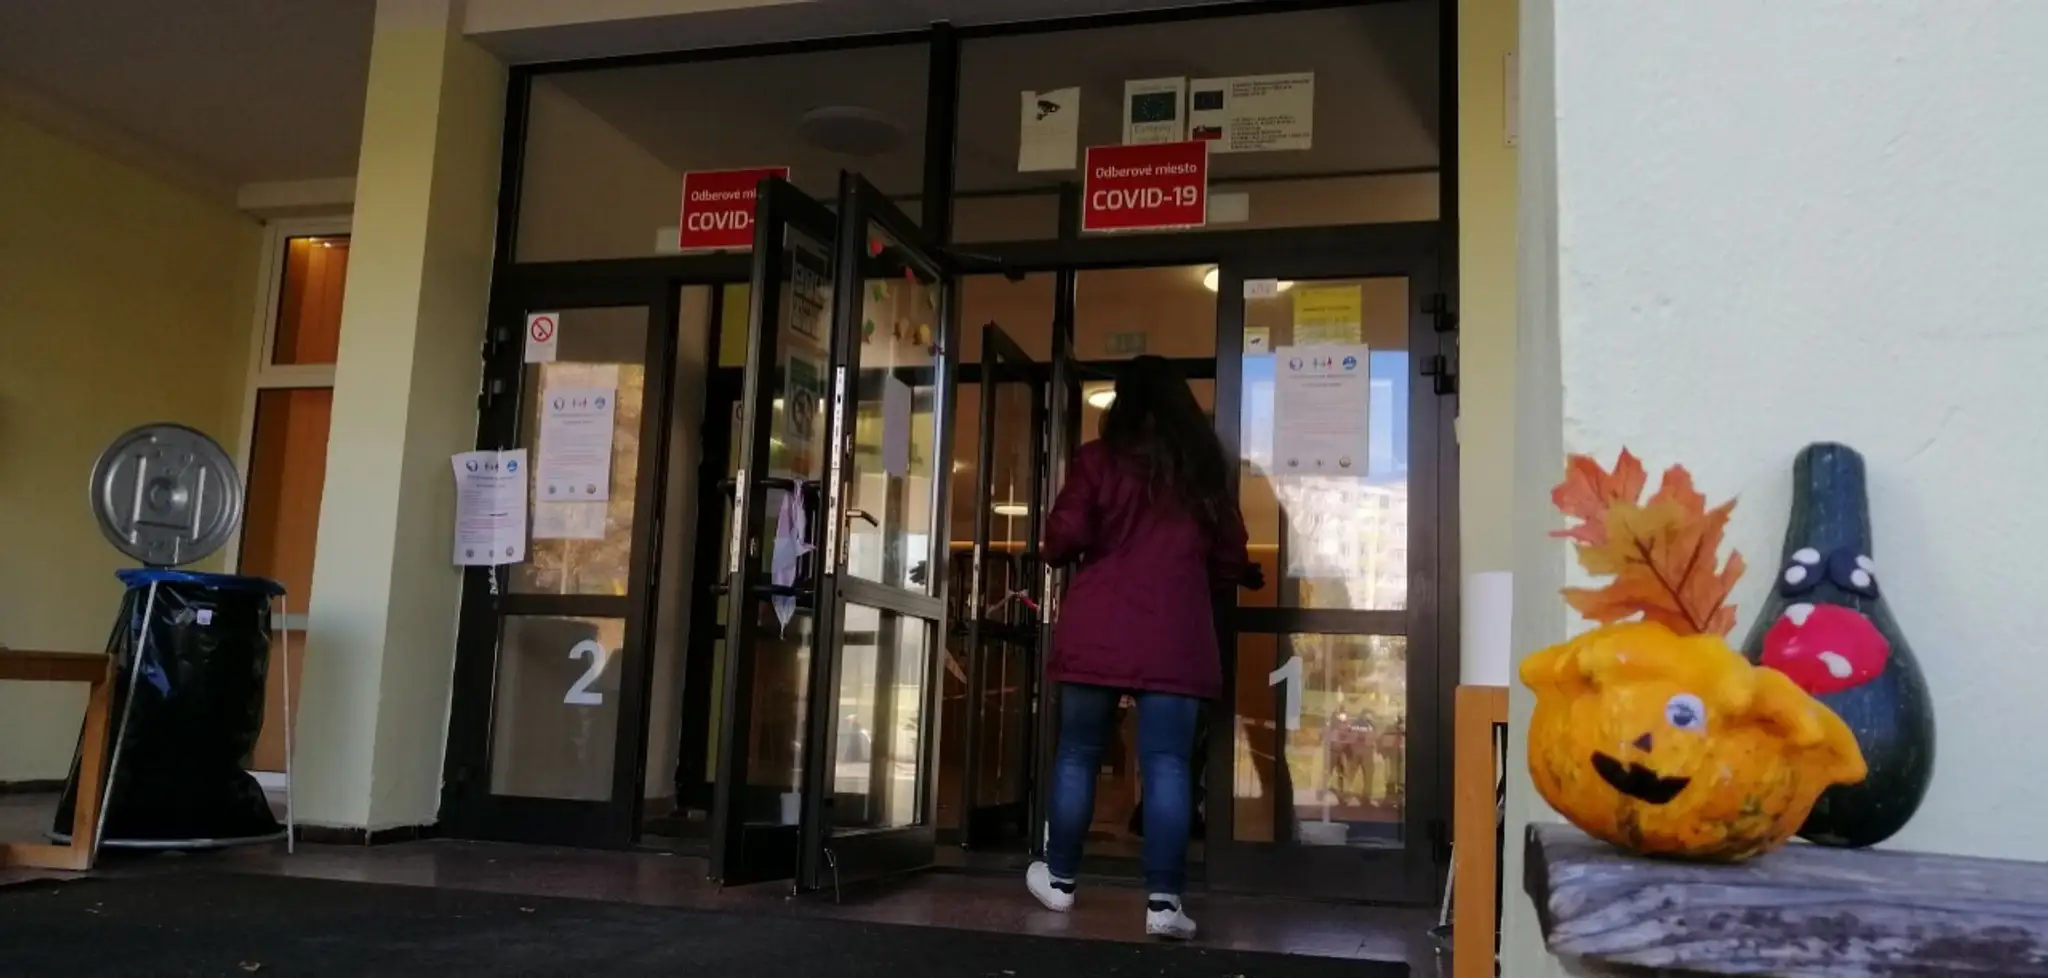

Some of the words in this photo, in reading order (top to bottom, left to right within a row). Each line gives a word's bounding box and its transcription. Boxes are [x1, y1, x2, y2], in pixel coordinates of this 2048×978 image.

[1095, 163, 1153, 178] Odberové
[1155, 162, 1197, 175] miesto
[691, 188, 741, 201] Odberové
[1093, 185, 1198, 211] COVID-19
[688, 209, 755, 231] COVID-
[563, 639, 606, 705] 2
[1268, 655, 1303, 731] 1
